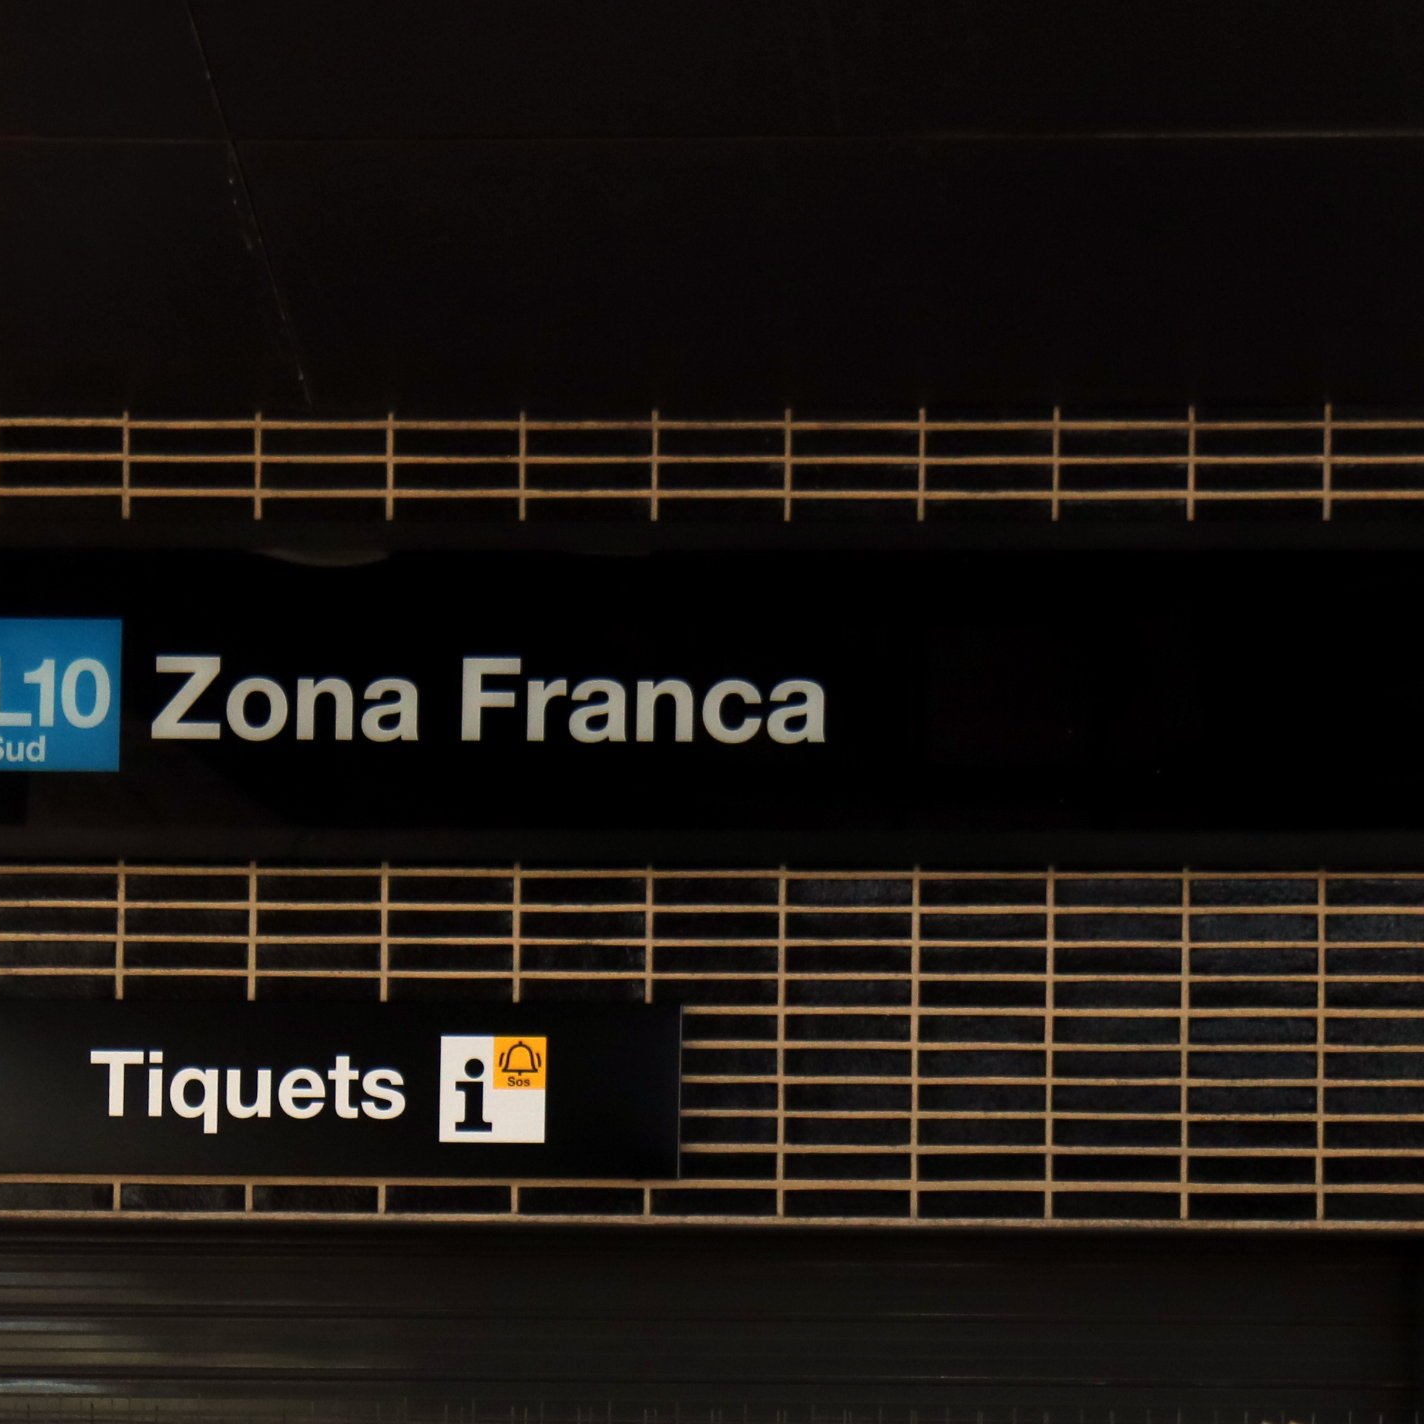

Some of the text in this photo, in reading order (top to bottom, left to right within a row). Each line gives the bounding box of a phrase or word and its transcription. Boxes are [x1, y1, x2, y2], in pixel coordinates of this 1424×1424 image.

[150, 655, 826, 744] Zona Franca
[89, 1050, 407, 1135] Tiquets
[506, 1076, 532, 1089] Sos
